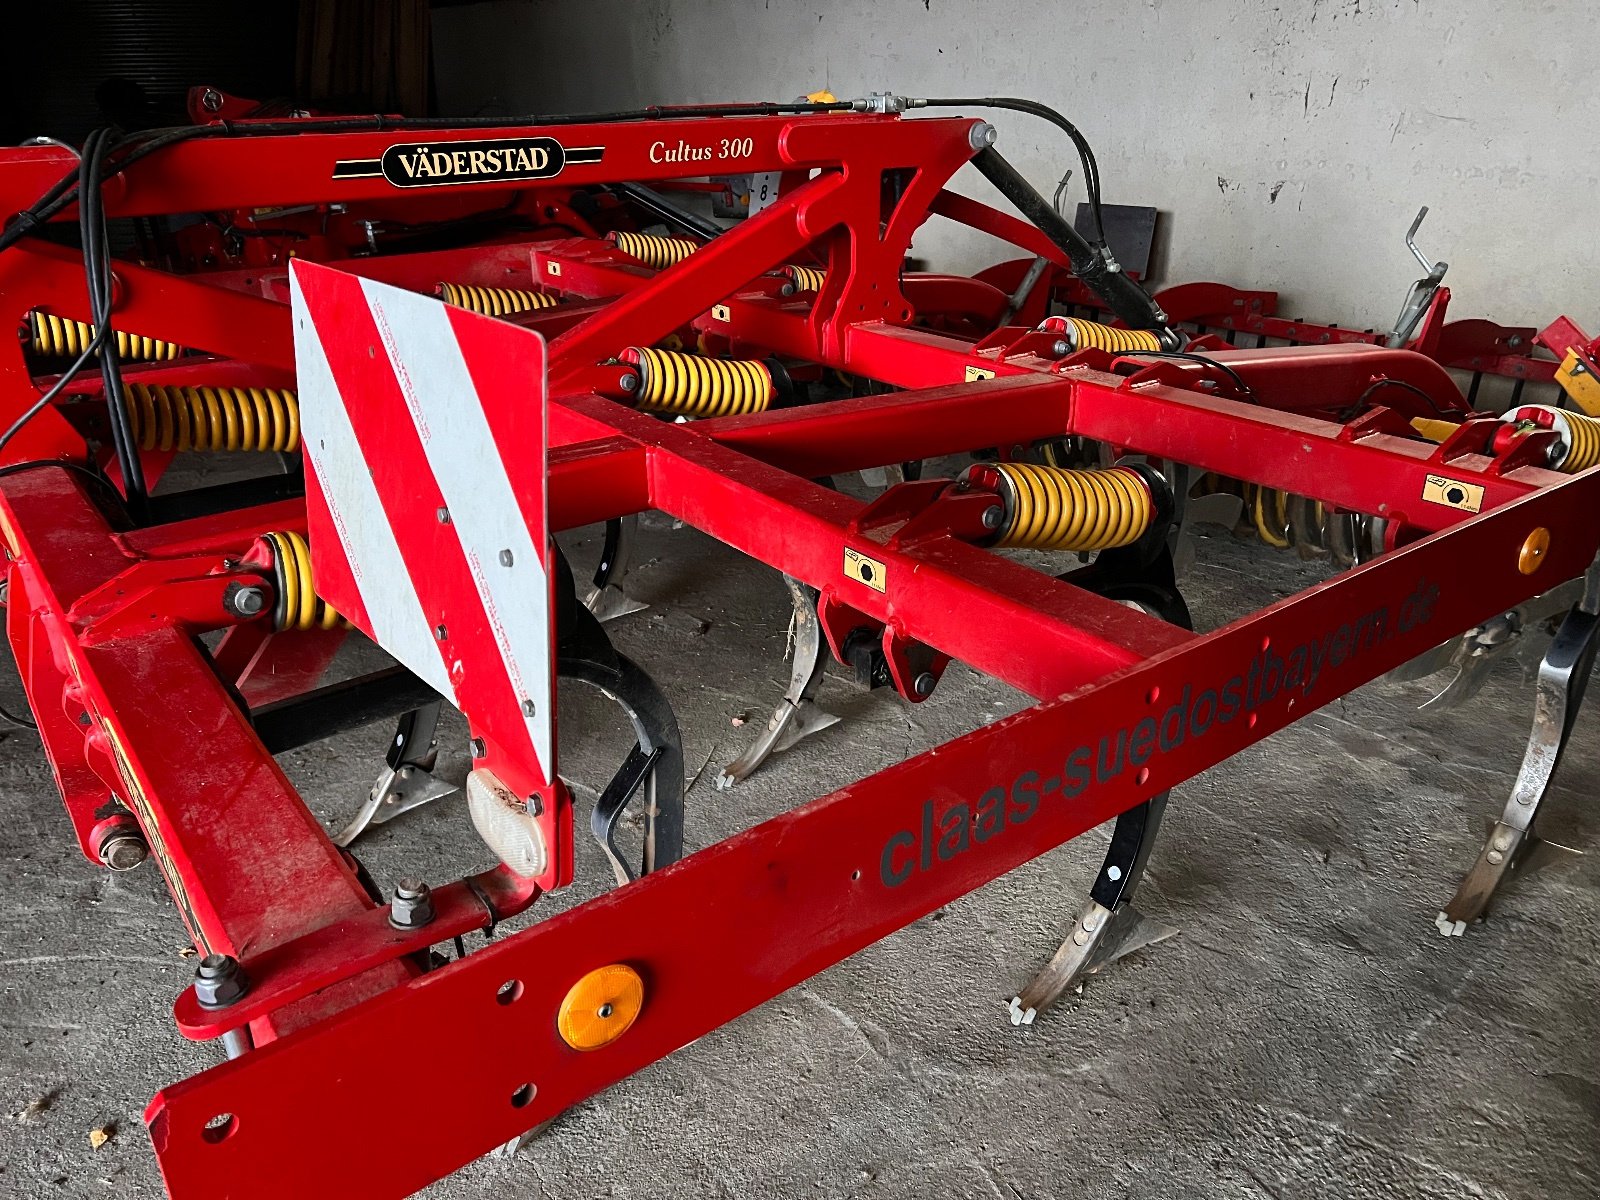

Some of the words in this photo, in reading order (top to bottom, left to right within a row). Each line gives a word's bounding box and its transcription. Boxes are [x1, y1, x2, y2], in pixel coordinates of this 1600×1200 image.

[398, 147, 549, 178] VÄDERSTAD
[648, 140, 713, 164] Cultus
[718, 137, 754, 159] 300
[759, 184, 769, 201] 8
[879, 575, 1440, 888] claas-suedostbayern.de
